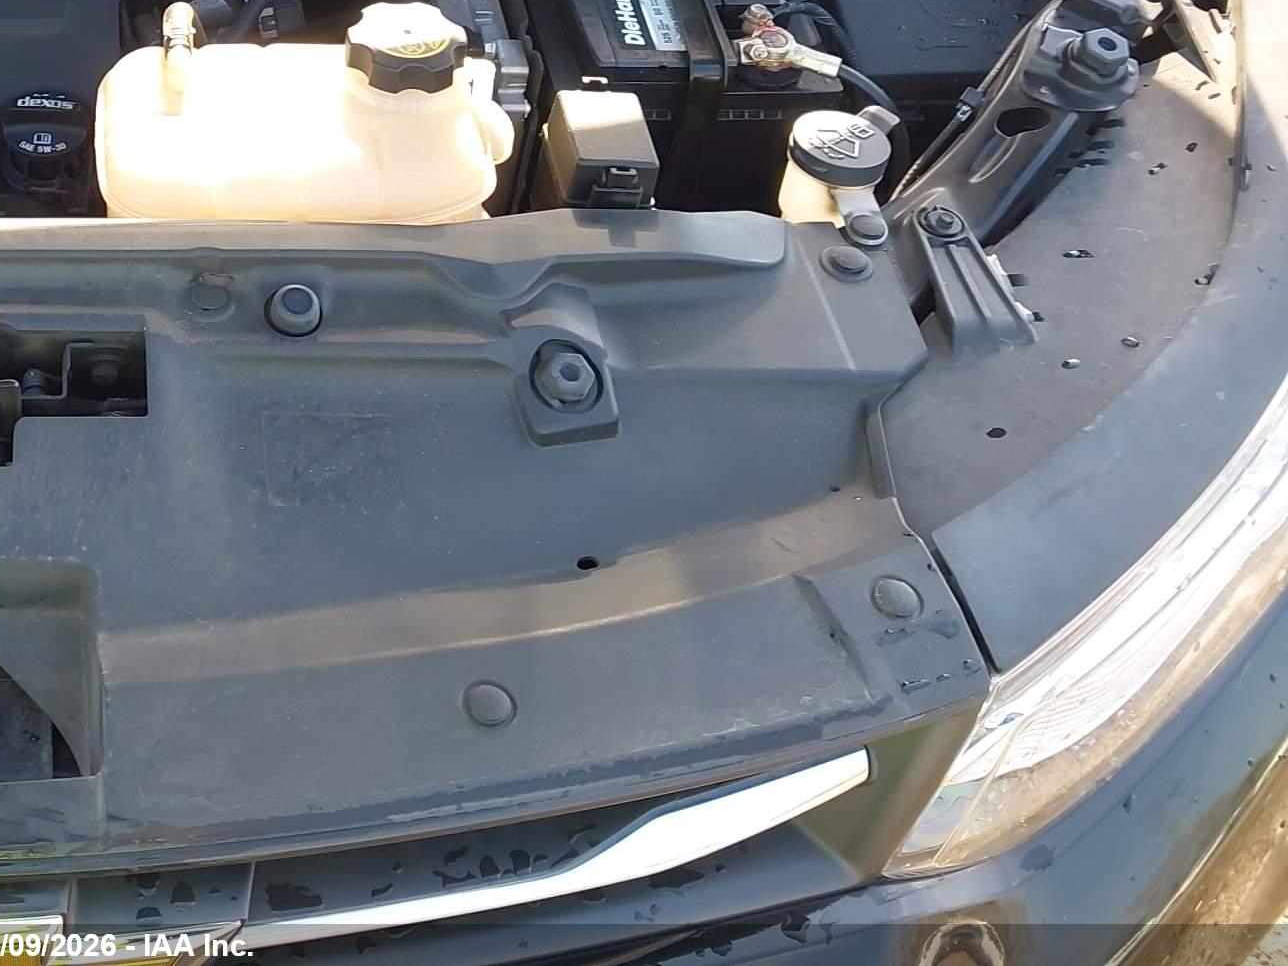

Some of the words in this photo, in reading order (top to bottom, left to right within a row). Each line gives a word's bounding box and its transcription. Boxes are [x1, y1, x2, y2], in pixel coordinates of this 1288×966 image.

[16, 96, 75, 110] dexos
[18, 141, 34, 152] SAE
[37, 143, 66, 153] 5W-30
